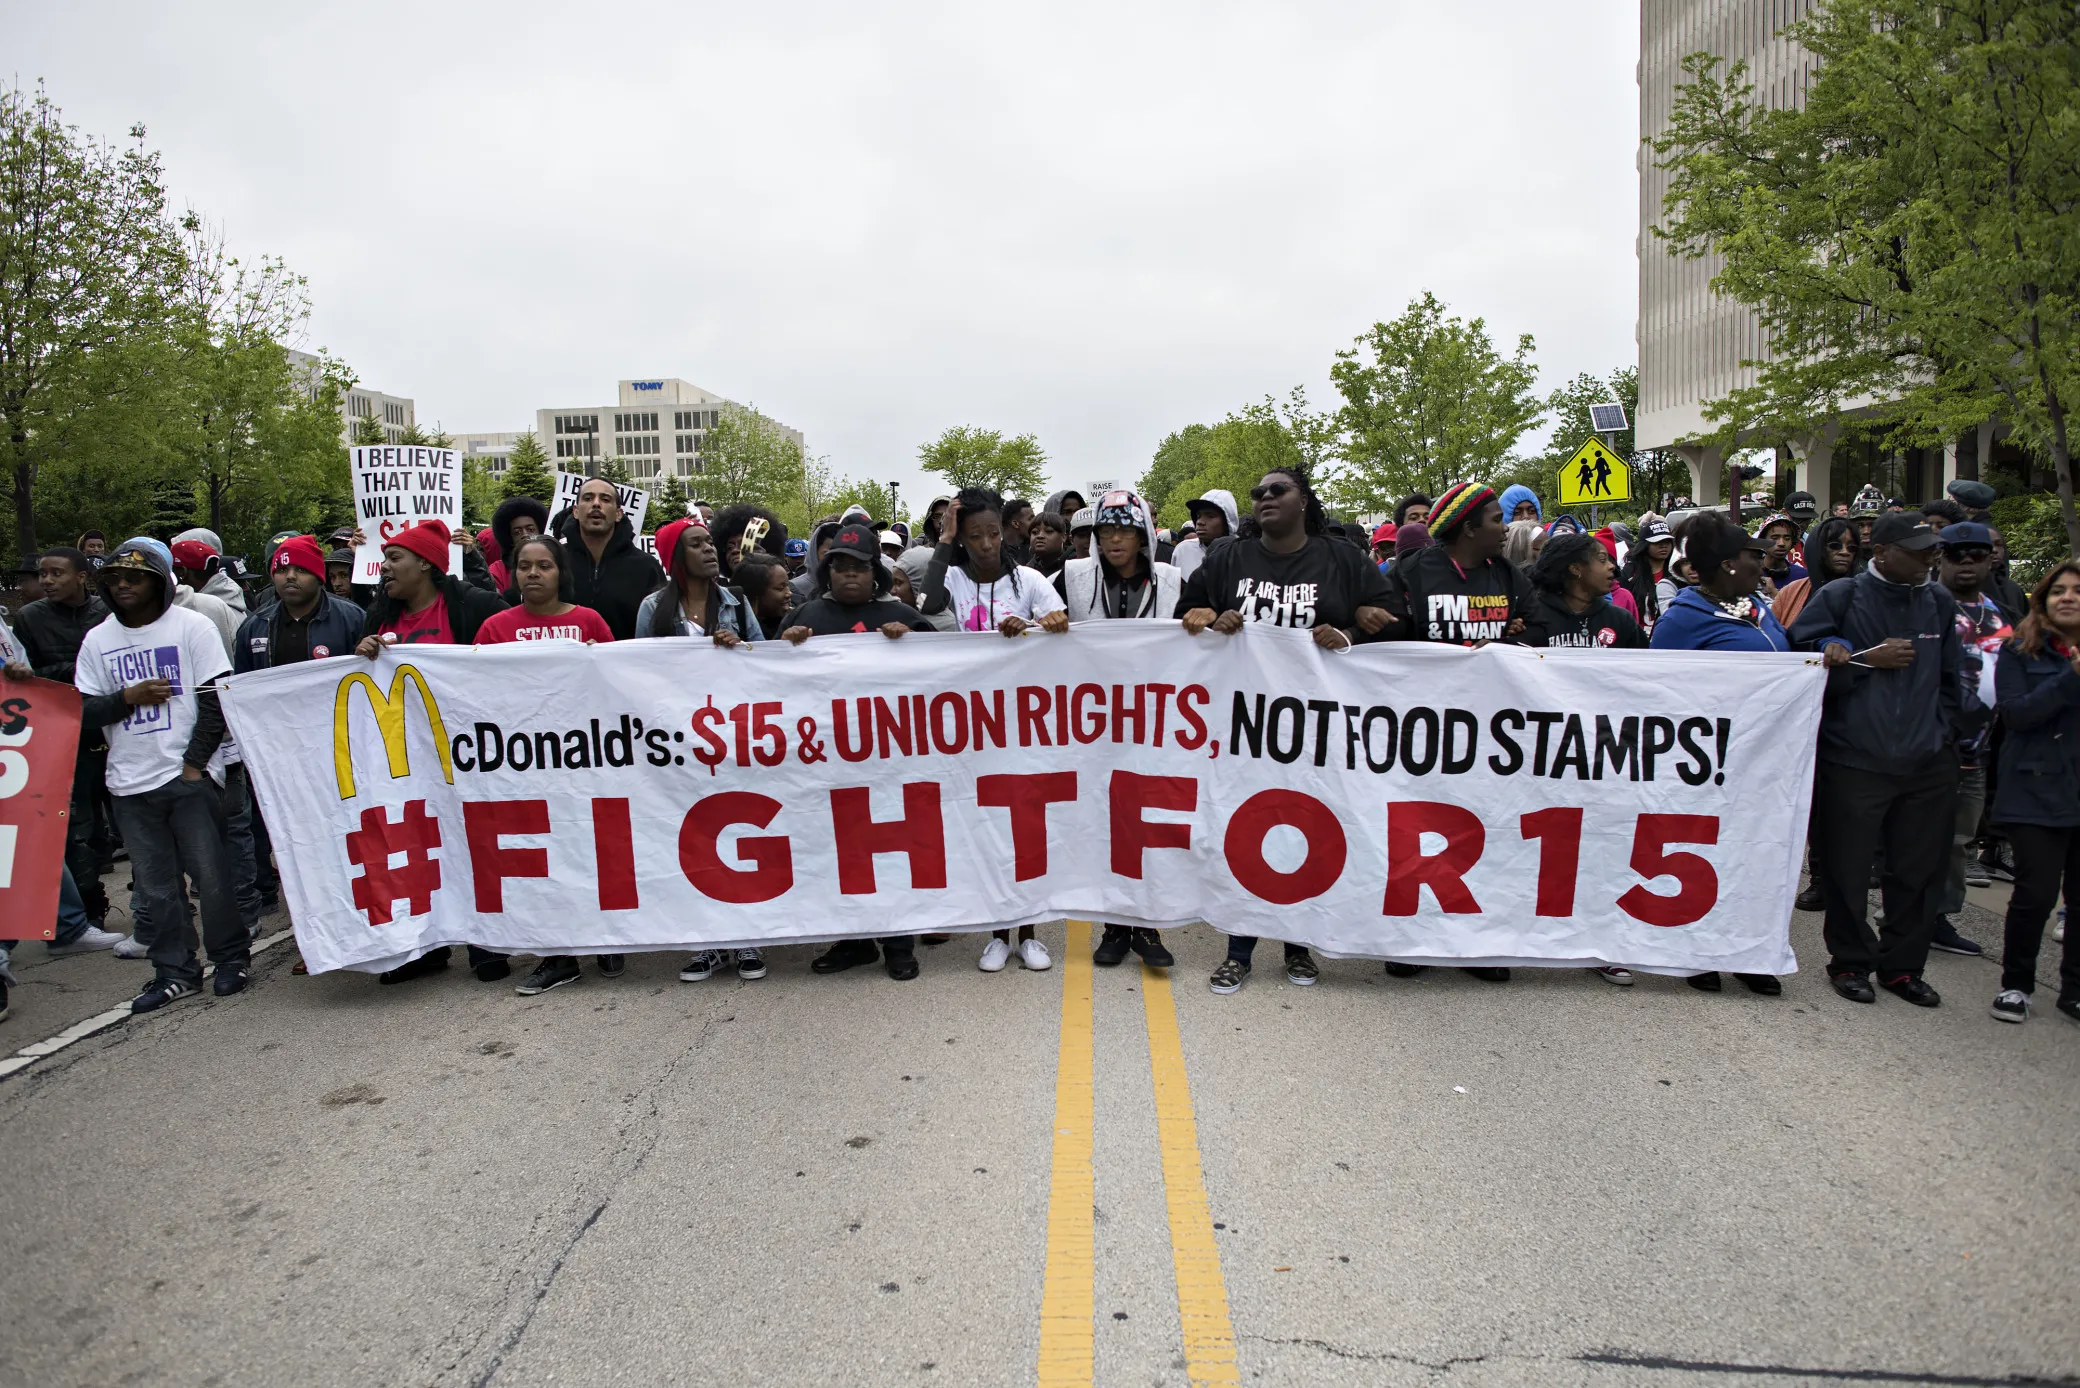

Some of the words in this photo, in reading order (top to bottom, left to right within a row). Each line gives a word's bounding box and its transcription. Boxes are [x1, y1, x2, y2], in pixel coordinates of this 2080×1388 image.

[632, 381, 664, 391] TOMY
[358, 449, 363, 469] I
[369, 448, 453, 470] BELIEVE
[361, 472, 412, 493] THAT
[418, 472, 450, 492] WE
[362, 495, 407, 518] WILL
[413, 495, 453, 515] WIN
[1236, 578, 1254, 598] WE
[1255, 581, 1281, 603] ARE
[1283, 583, 1318, 603] HERE
[1468, 595, 1508, 608] YOUNG
[1468, 607, 1508, 621] BLACK
[515, 625, 582, 642] STAND
[1428, 622, 1443, 639] &
[1448, 621, 1455, 639] I
[109, 648, 155, 684] FIGHT
[158, 664, 179, 680] FOR
[691, 695, 787, 776] $15
[797, 716, 827, 764] &
[831, 690, 1006, 762] UNION
[1017, 683, 1219, 759] RIGHTS,
[1229, 691, 1339, 767] NOT
[1346, 705, 1479, 776] FOOD
[1488, 708, 1731, 787] STAMPS!
